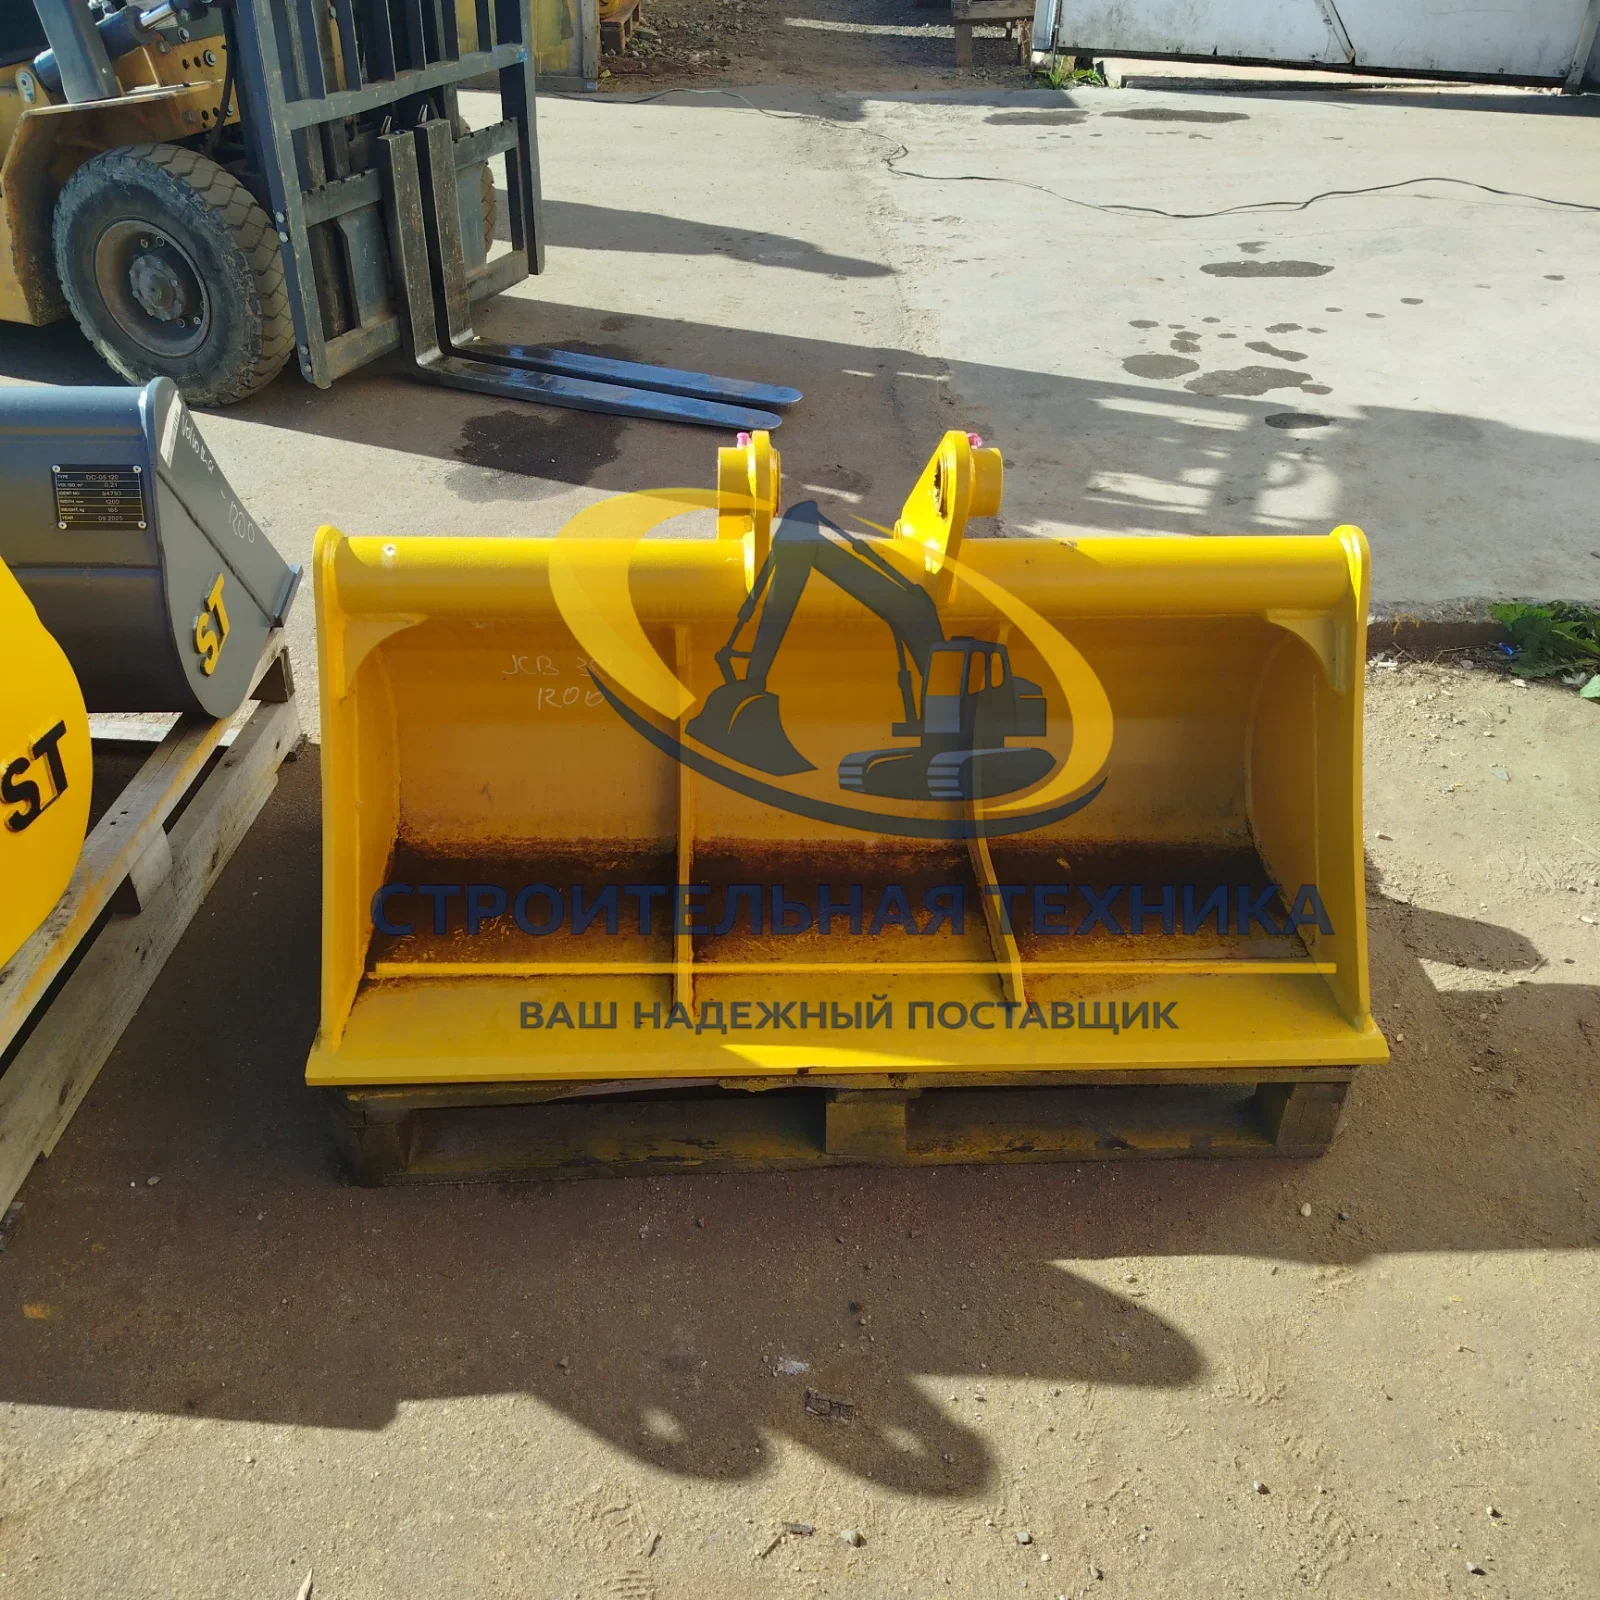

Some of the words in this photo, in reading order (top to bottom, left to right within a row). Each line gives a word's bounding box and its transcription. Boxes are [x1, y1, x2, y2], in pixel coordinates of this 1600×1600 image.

[192, 572, 230, 676] ST
[502, 654, 560, 676] JCB
[1, 719, 68, 833] ST
